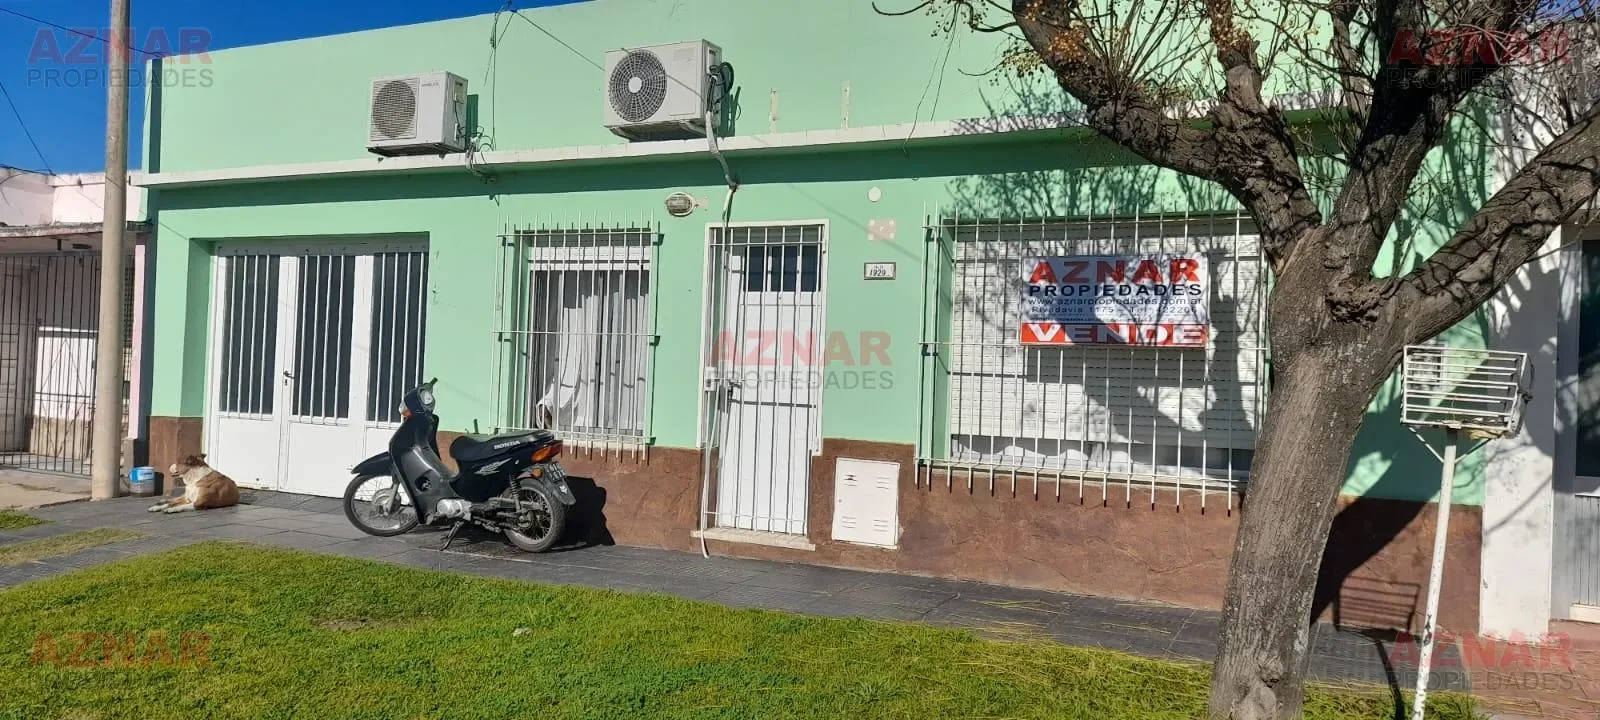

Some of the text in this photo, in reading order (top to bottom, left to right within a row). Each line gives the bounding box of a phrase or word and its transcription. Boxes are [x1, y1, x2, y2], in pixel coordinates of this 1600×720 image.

[1029, 259, 1200, 284] AZNAR
[1029, 284, 1202, 297] PROPIEDADES
[1031, 306, 1083, 314] Rivadavia
[1089, 306, 1114, 314] 1175
[1028, 323, 1204, 345] VENDE
[494, 440, 520, 450] HONDA
